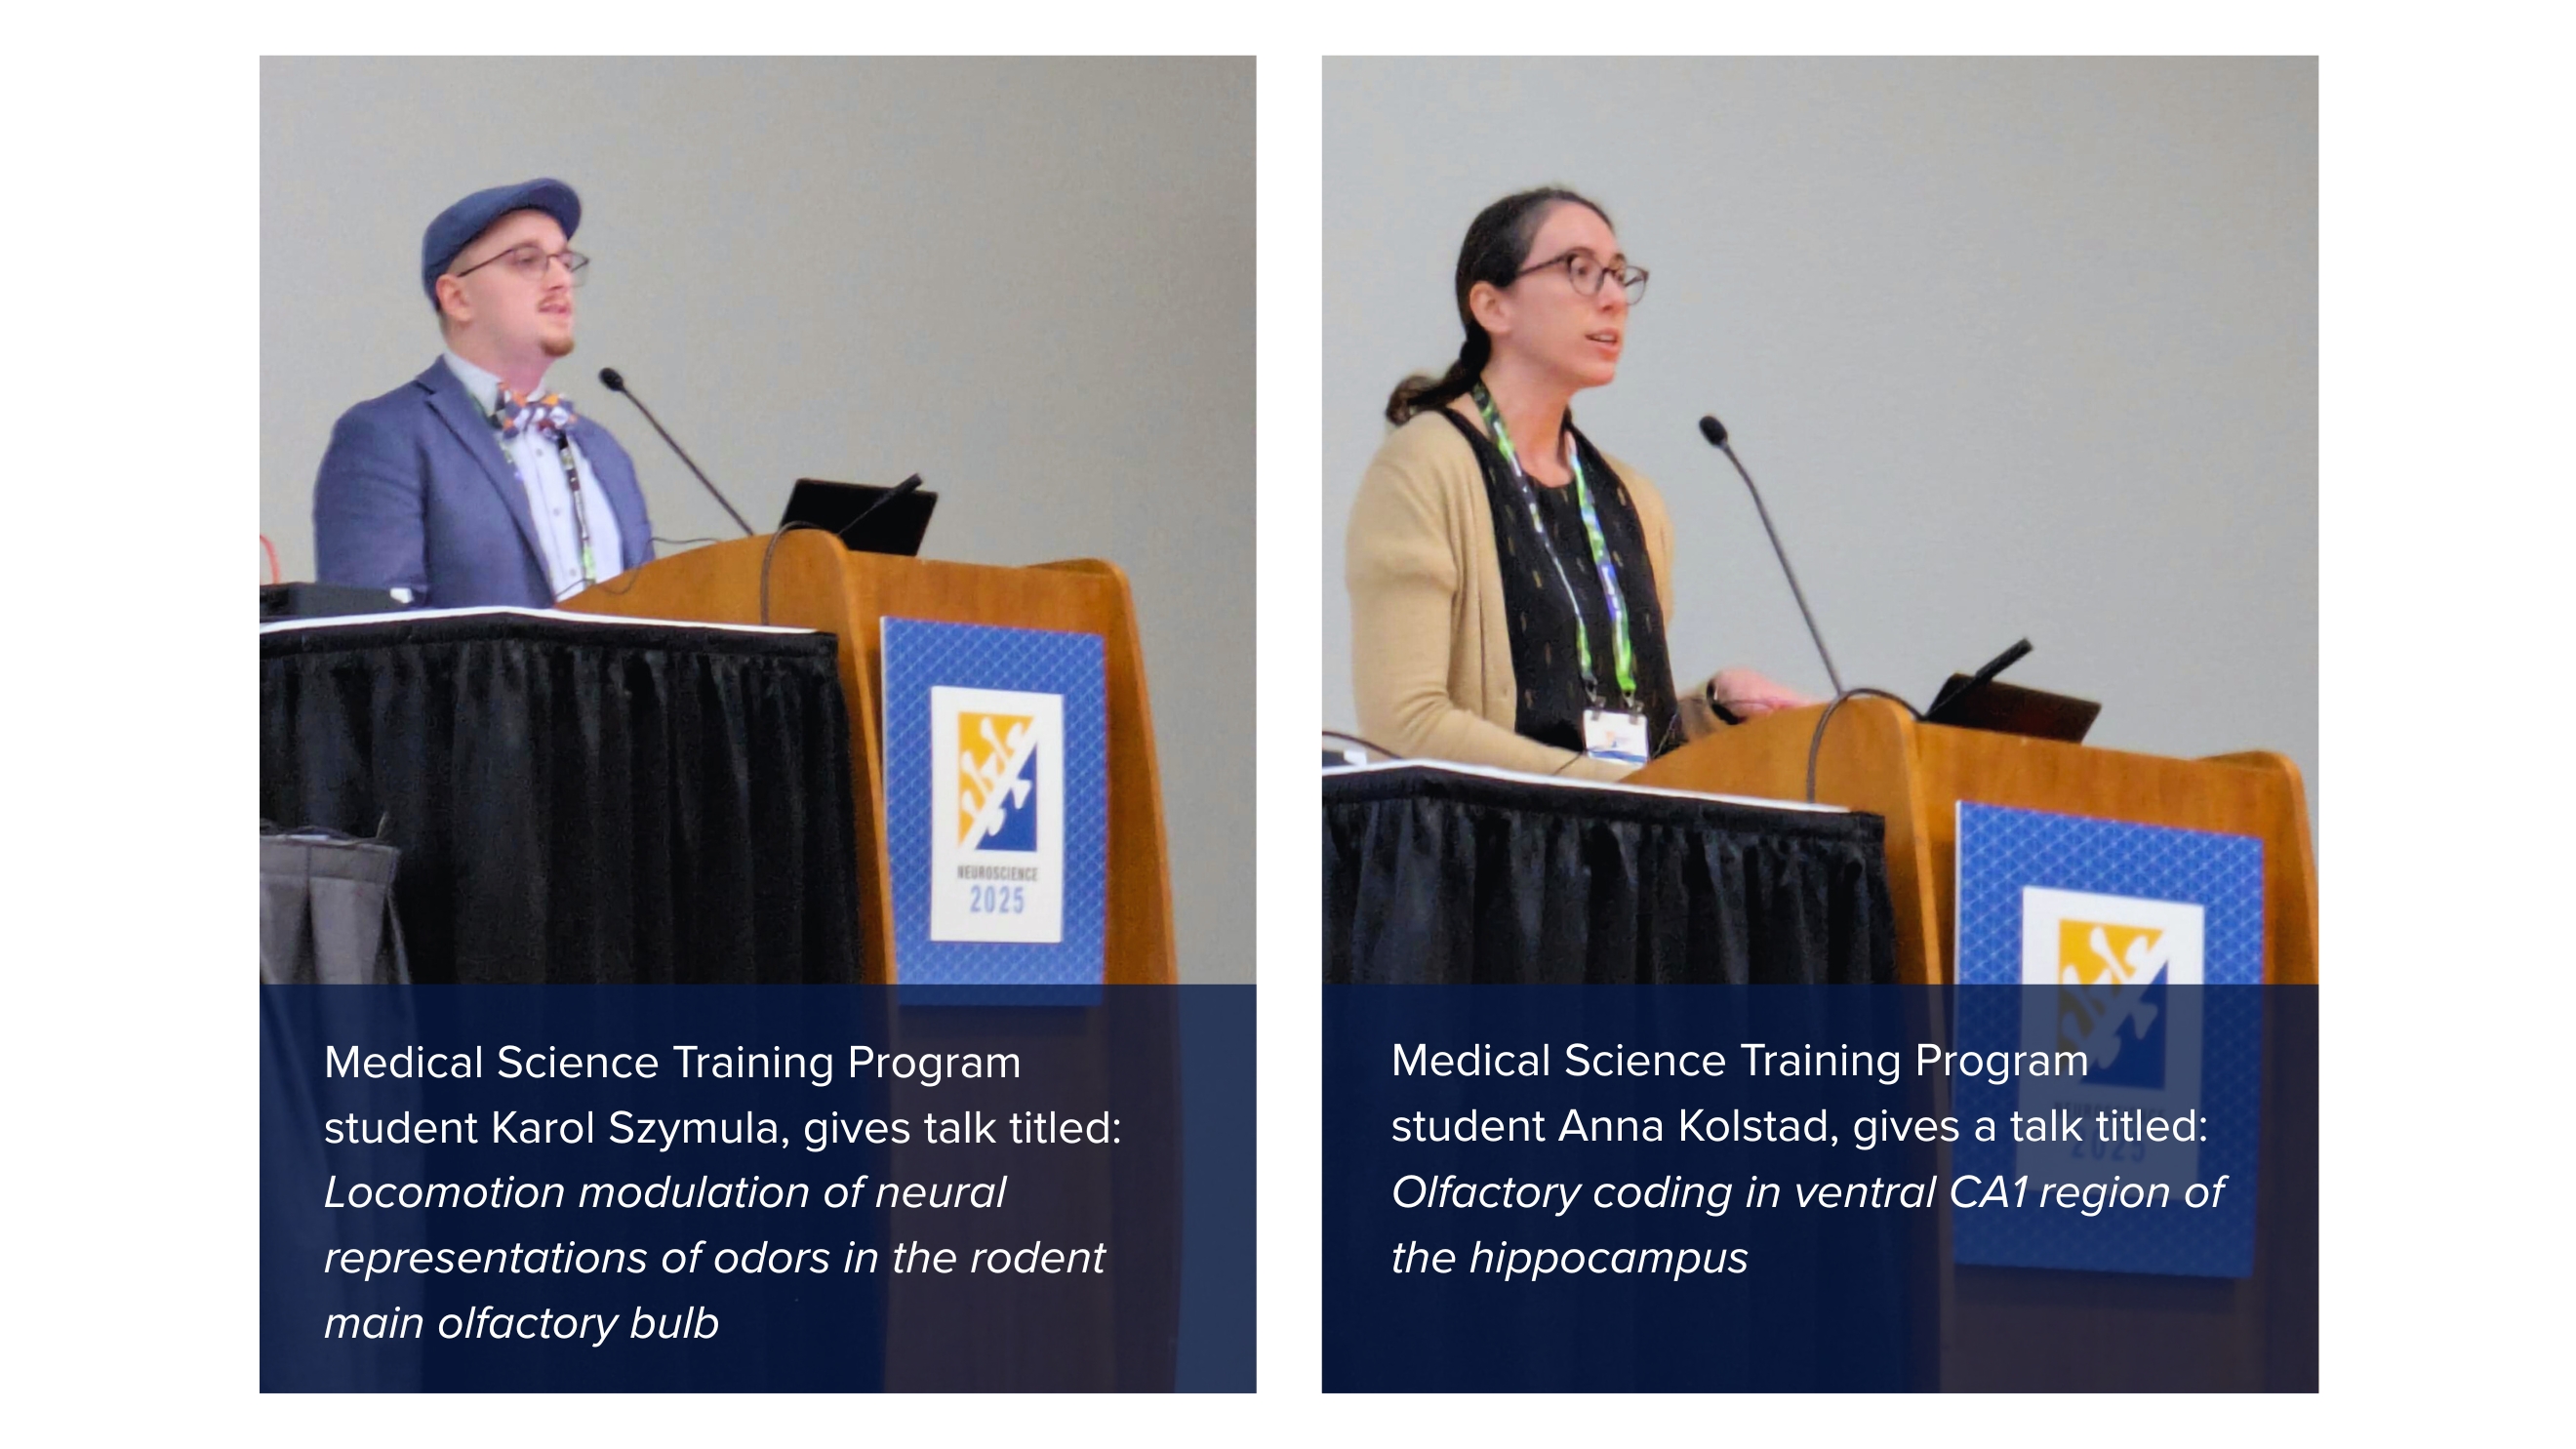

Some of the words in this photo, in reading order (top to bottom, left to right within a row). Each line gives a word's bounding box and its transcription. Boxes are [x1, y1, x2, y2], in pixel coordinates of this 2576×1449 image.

[957, 865, 1038, 882] NEUROSCIENCE
[970, 884, 1024, 914] 2025
[2054, 1102, 2166, 1125] NEUROSCENCE
